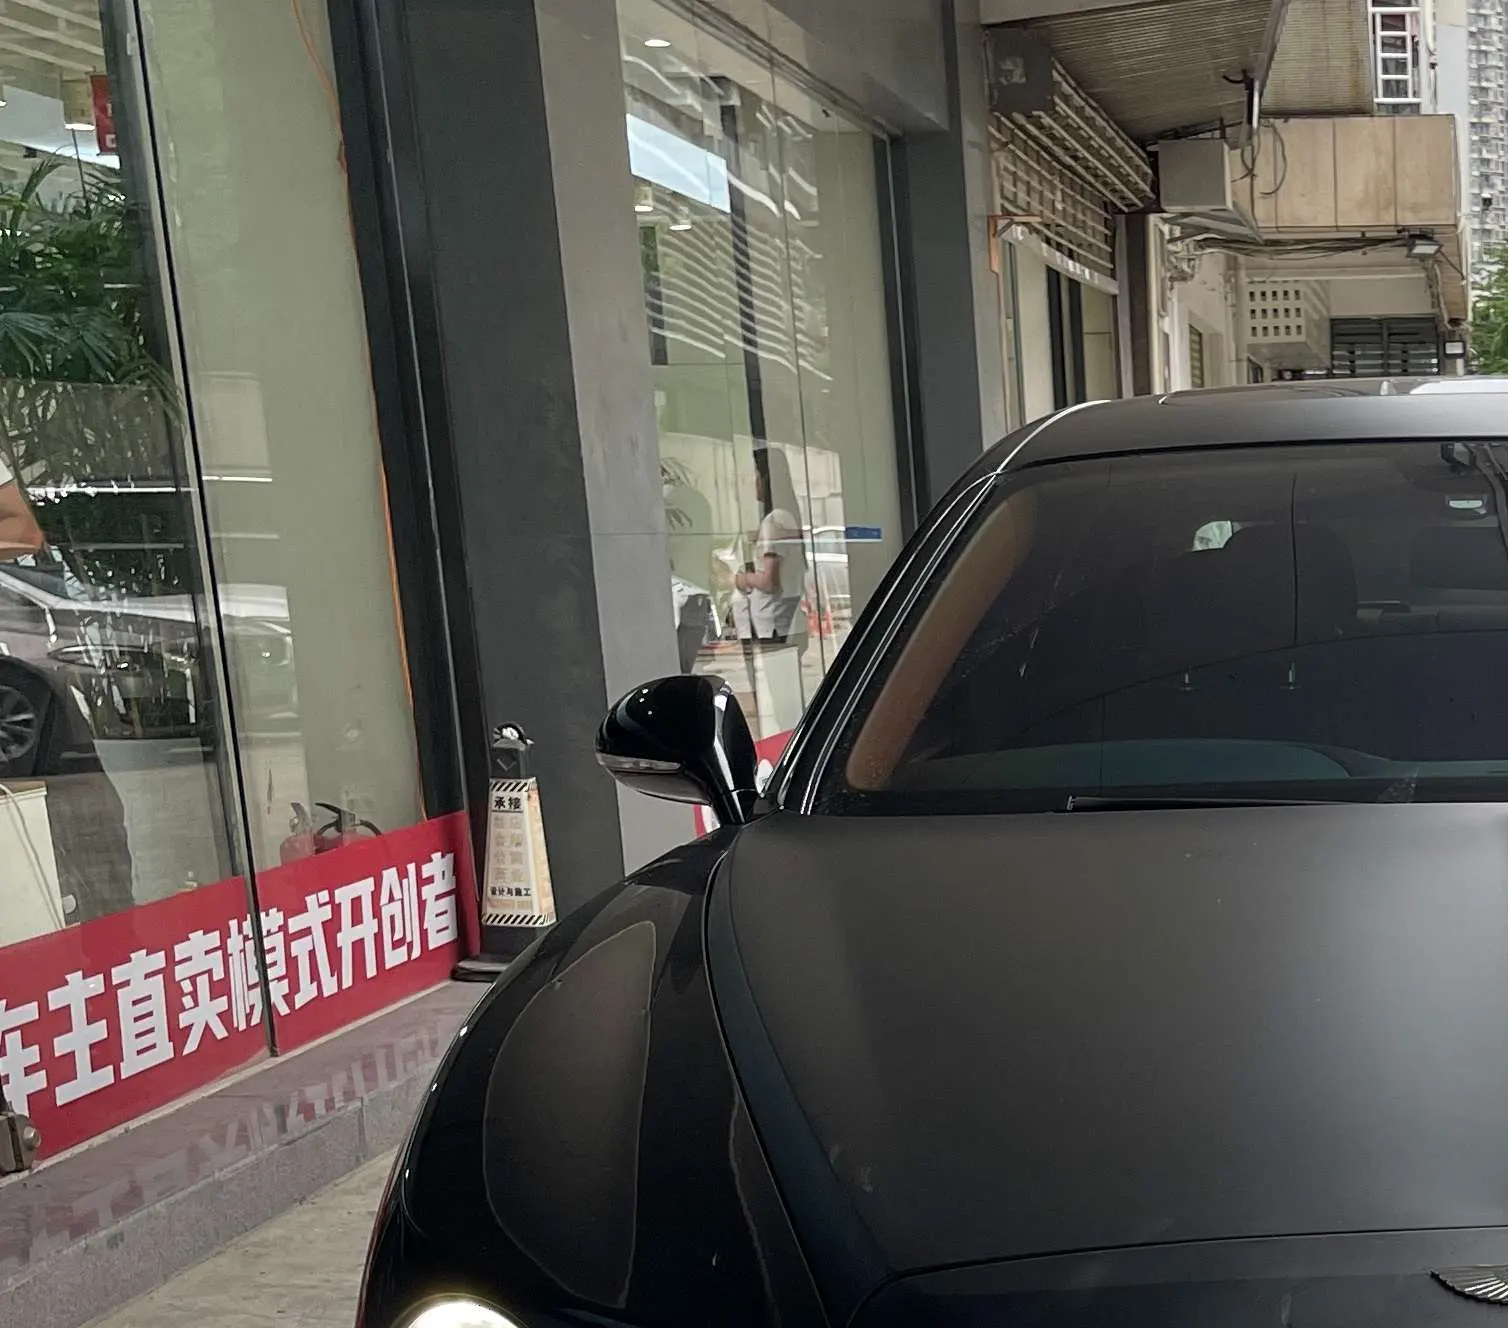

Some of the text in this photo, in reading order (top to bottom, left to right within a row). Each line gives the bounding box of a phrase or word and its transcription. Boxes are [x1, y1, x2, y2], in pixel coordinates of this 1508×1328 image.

[0, 852, 459, 1118] 车主直卖模式开创者
